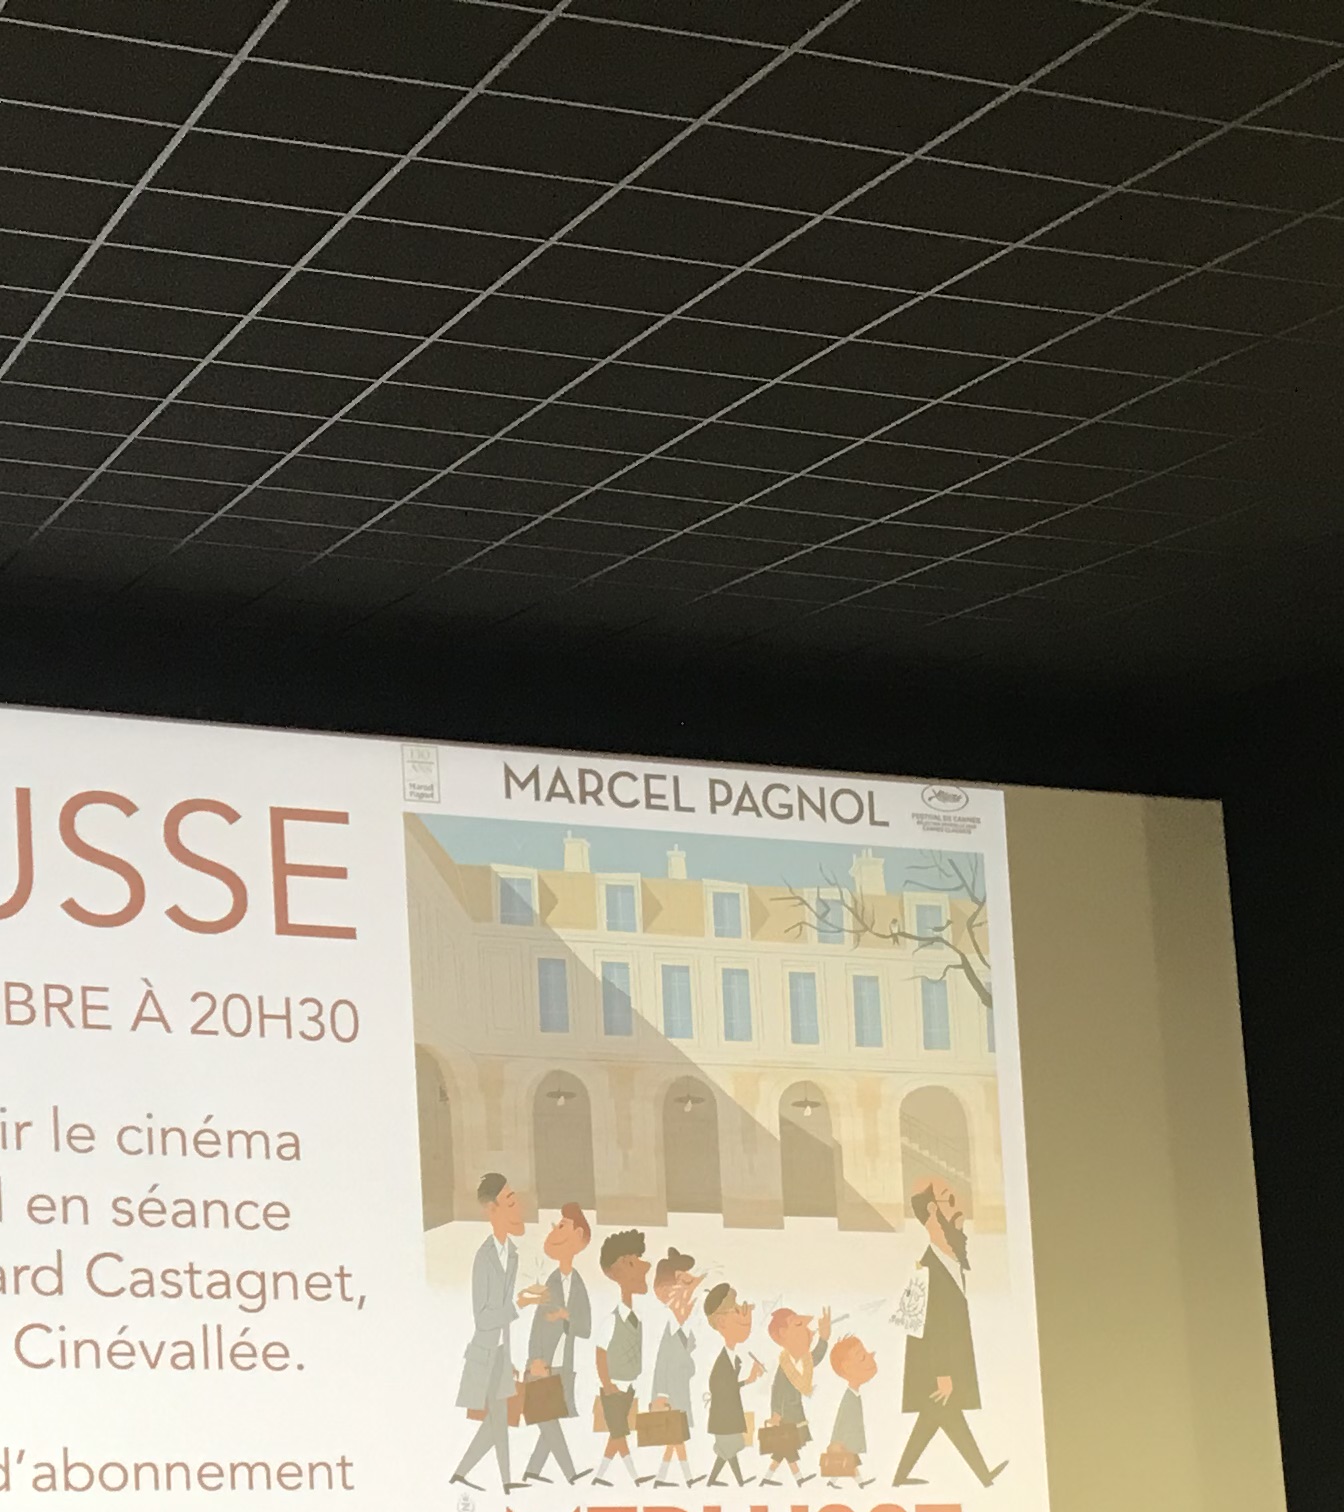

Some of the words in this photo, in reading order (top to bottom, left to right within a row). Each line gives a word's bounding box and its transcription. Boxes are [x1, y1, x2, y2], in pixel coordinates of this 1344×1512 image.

[503, 761, 697, 814] MARCEL
[708, 777, 890, 828] PAGNOL
[129, 977, 173, 1034] À
[189, 990, 360, 1044] 20H30
[52, 1104, 97, 1155] le
[116, 1110, 302, 1162] cinéma
[26, 1193, 90, 1226] en
[111, 1182, 292, 1232] séance
[85, 1251, 367, 1314] Castagnet,
[13, 1322, 305, 1373] Cinévallée.
